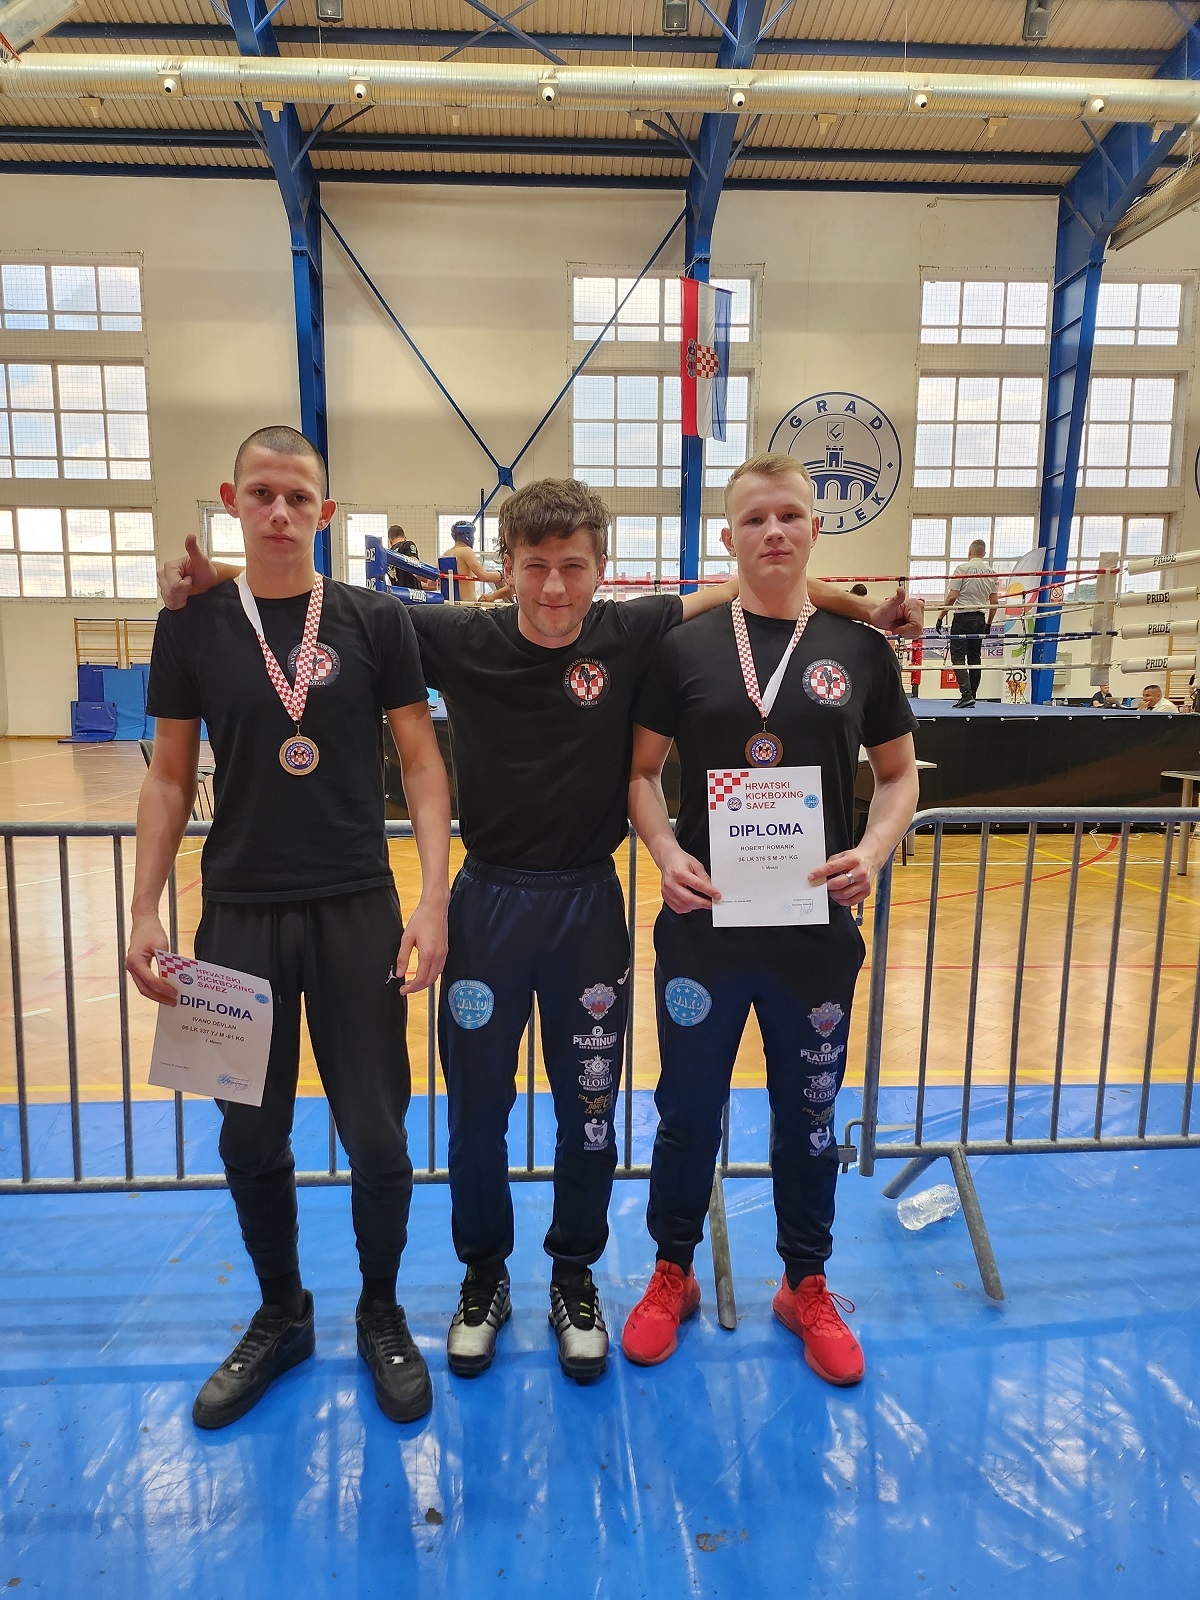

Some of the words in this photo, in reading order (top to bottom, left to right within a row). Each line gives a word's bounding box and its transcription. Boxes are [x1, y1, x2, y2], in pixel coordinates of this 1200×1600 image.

[790, 400, 883, 430] GRAD
[820, 491, 886, 529] IJEK
[1153, 554, 1177, 566] PRIDE
[1146, 592, 1170, 604] PRIDE
[1148, 622, 1171, 635] PRIDE
[1145, 657, 1169, 669] PRIDE
[745, 781, 790, 790] HRVATSKI
[745, 790, 804, 800] KICKBOXING
[746, 801, 776, 810] SAVEZ
[729, 822, 804, 837] DIPLOMA
[195, 968, 241, 984] HRVATSKI
[196, 974, 255, 994] KICKBOXING
[198, 981, 228, 993] SAVEZ
[180, 994, 253, 1021] DIPLOMA
[193, 1016, 212, 1025] IVANO
[212, 1020, 237, 1030] DEVLAN
